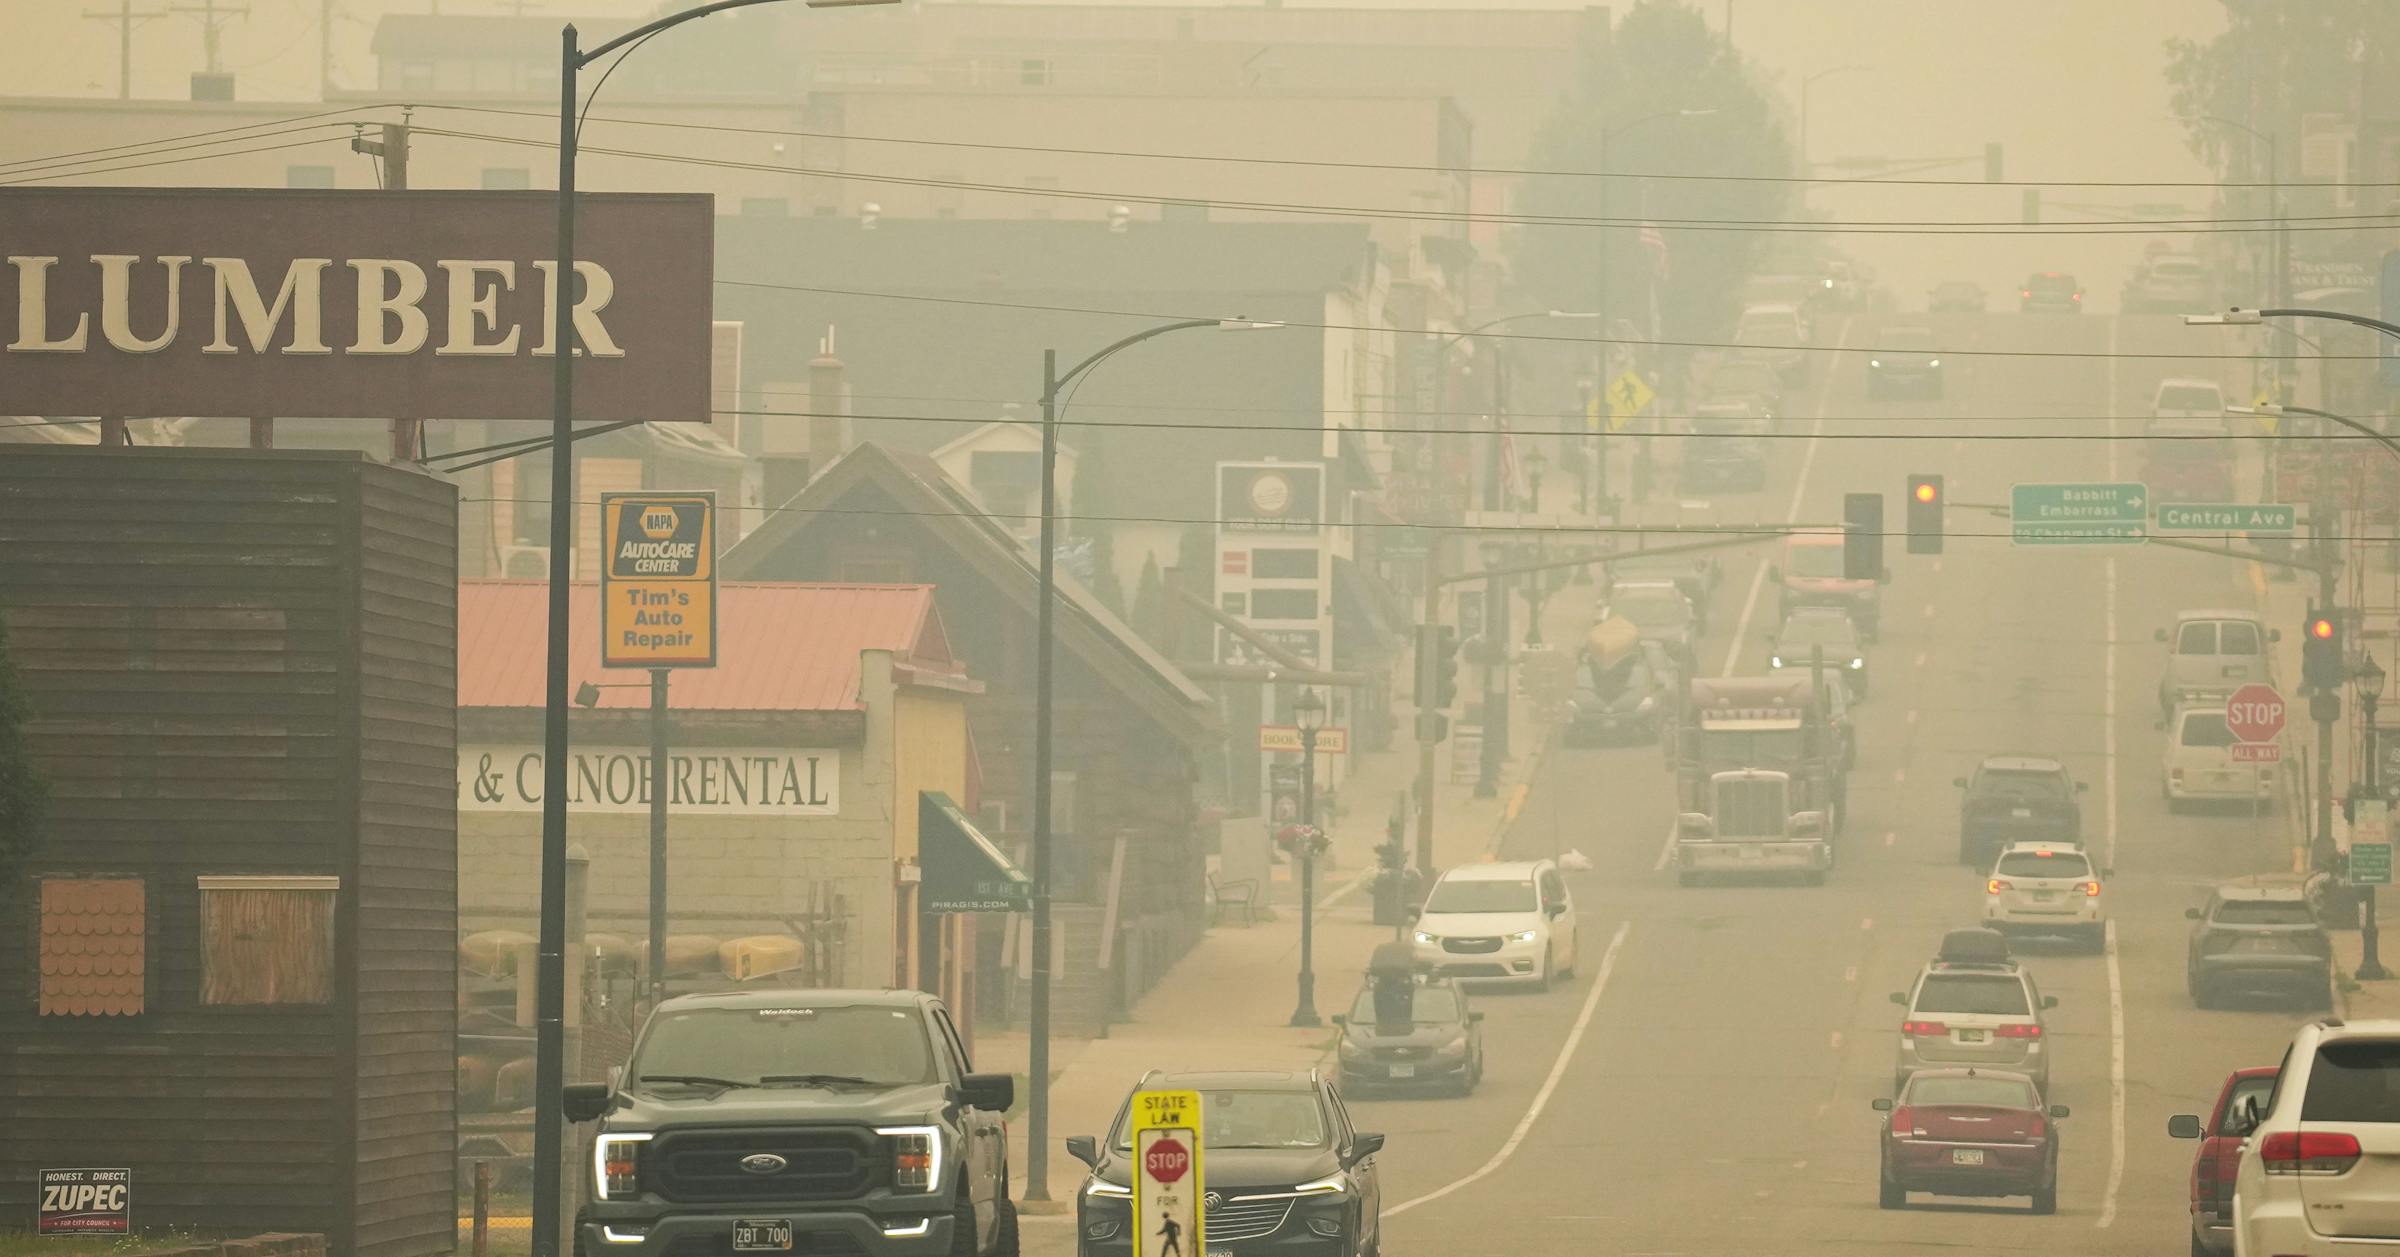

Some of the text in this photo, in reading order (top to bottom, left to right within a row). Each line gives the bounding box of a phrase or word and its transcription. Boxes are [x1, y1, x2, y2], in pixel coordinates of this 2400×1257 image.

[7, 254, 625, 357] LUMBER
[2063, 489, 2118, 501] Babbitt
[2039, 505, 2118, 517] Embarrass
[2167, 511, 2287, 525] Central Ave
[646, 514, 674, 530] NAPA
[635, 559, 680, 573] CENTER
[627, 588, 690, 606] Tim's
[634, 609, 683, 626] Auto
[624, 631, 693, 651] Repair
[2230, 702, 2283, 726] STOP
[2233, 747, 2278, 761] ALL WAY
[474, 752, 830, 807] & CNOE RENTAL
[932, 901, 1009, 909] PIRAGIS.COM
[1144, 1096, 1187, 1109] STATE
[1151, 1112, 1180, 1125] LAW
[1147, 1153, 1187, 1169] STOP
[46, 1171, 126, 1182] HONEST. DIRECT.
[42, 1184, 127, 1212] ZUPEC
[1156, 1195, 1178, 1207] FOR
[60, 1218, 110, 1227] FOR CITY COUNCIL
[736, 1227, 789, 1243] ZBT 700
